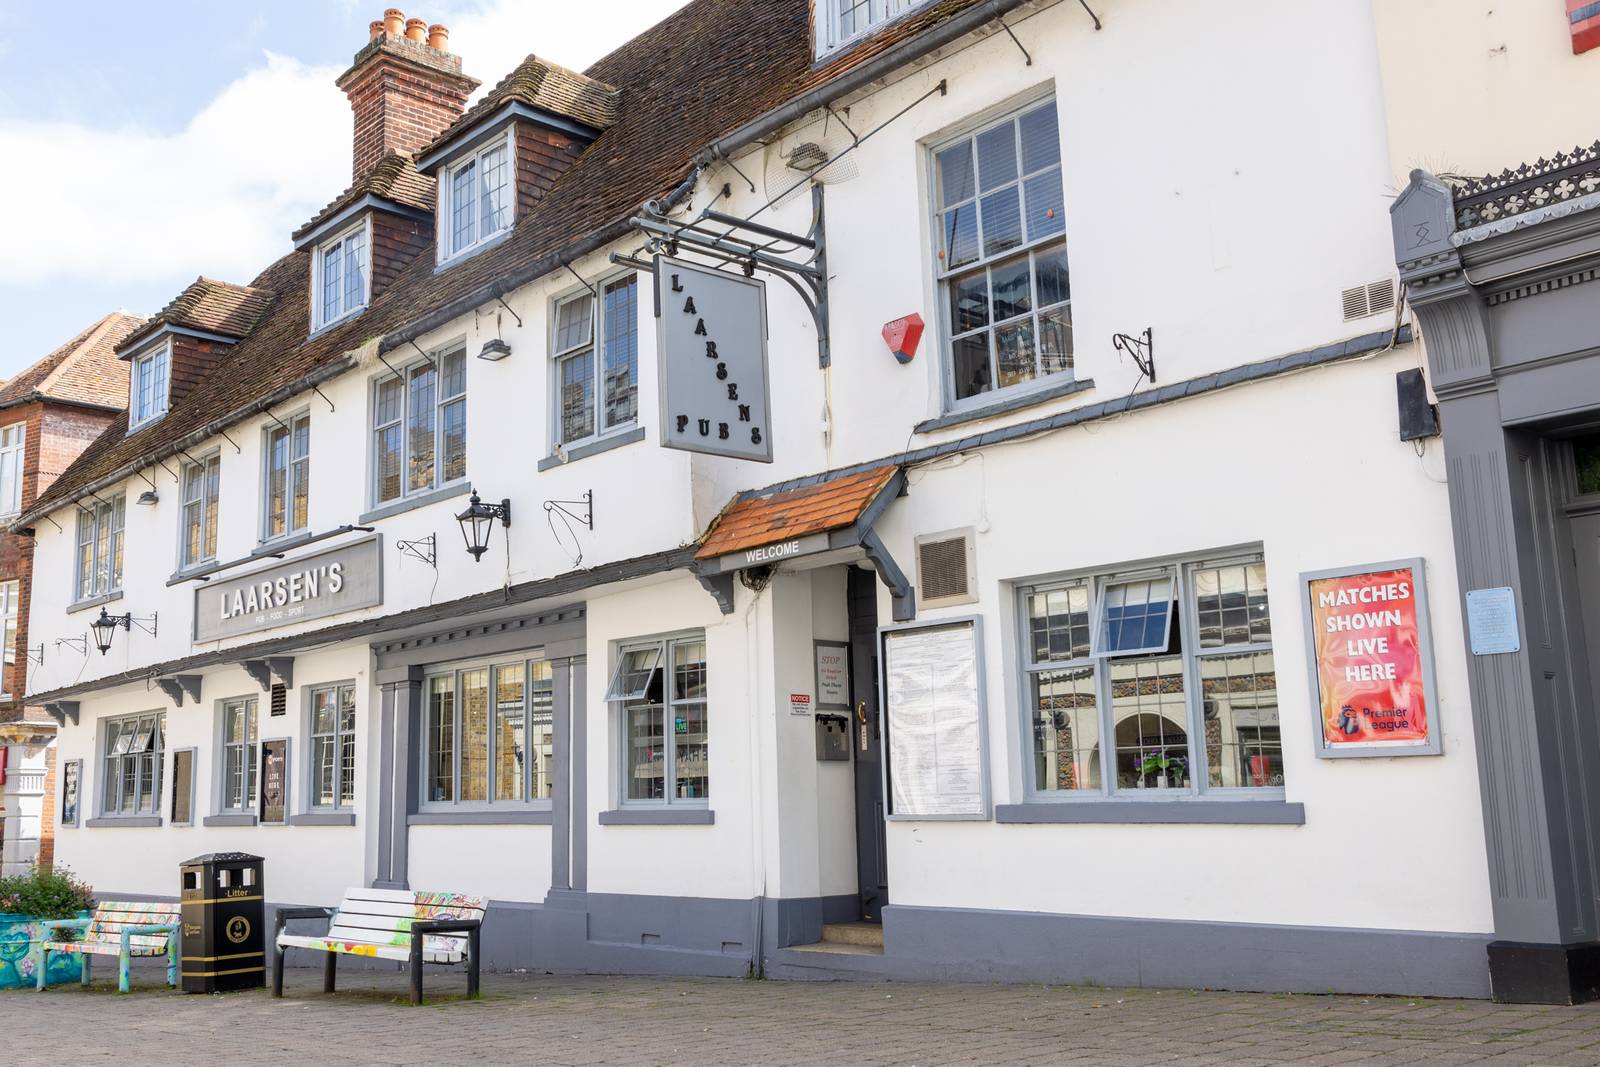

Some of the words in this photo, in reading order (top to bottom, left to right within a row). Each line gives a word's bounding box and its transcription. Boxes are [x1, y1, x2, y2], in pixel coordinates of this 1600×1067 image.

[745, 540, 799, 563] WELCOME
[220, 563, 343, 619] LAARSEN'S
[1318, 582, 1409, 608] MATCHES
[255, 615, 265, 624] PUB
[270, 610, 283, 620] FOOD
[288, 606, 304, 617] SPORT
[1326, 609, 1401, 633] SHOWN
[1347, 636, 1389, 657] LIVE
[1345, 662, 1397, 682] HERE
[791, 695, 809, 703] NOTICE
[1362, 707, 1408, 718] Premier
[1364, 719, 1409, 732] League
[227, 888, 248, 897] Litter
